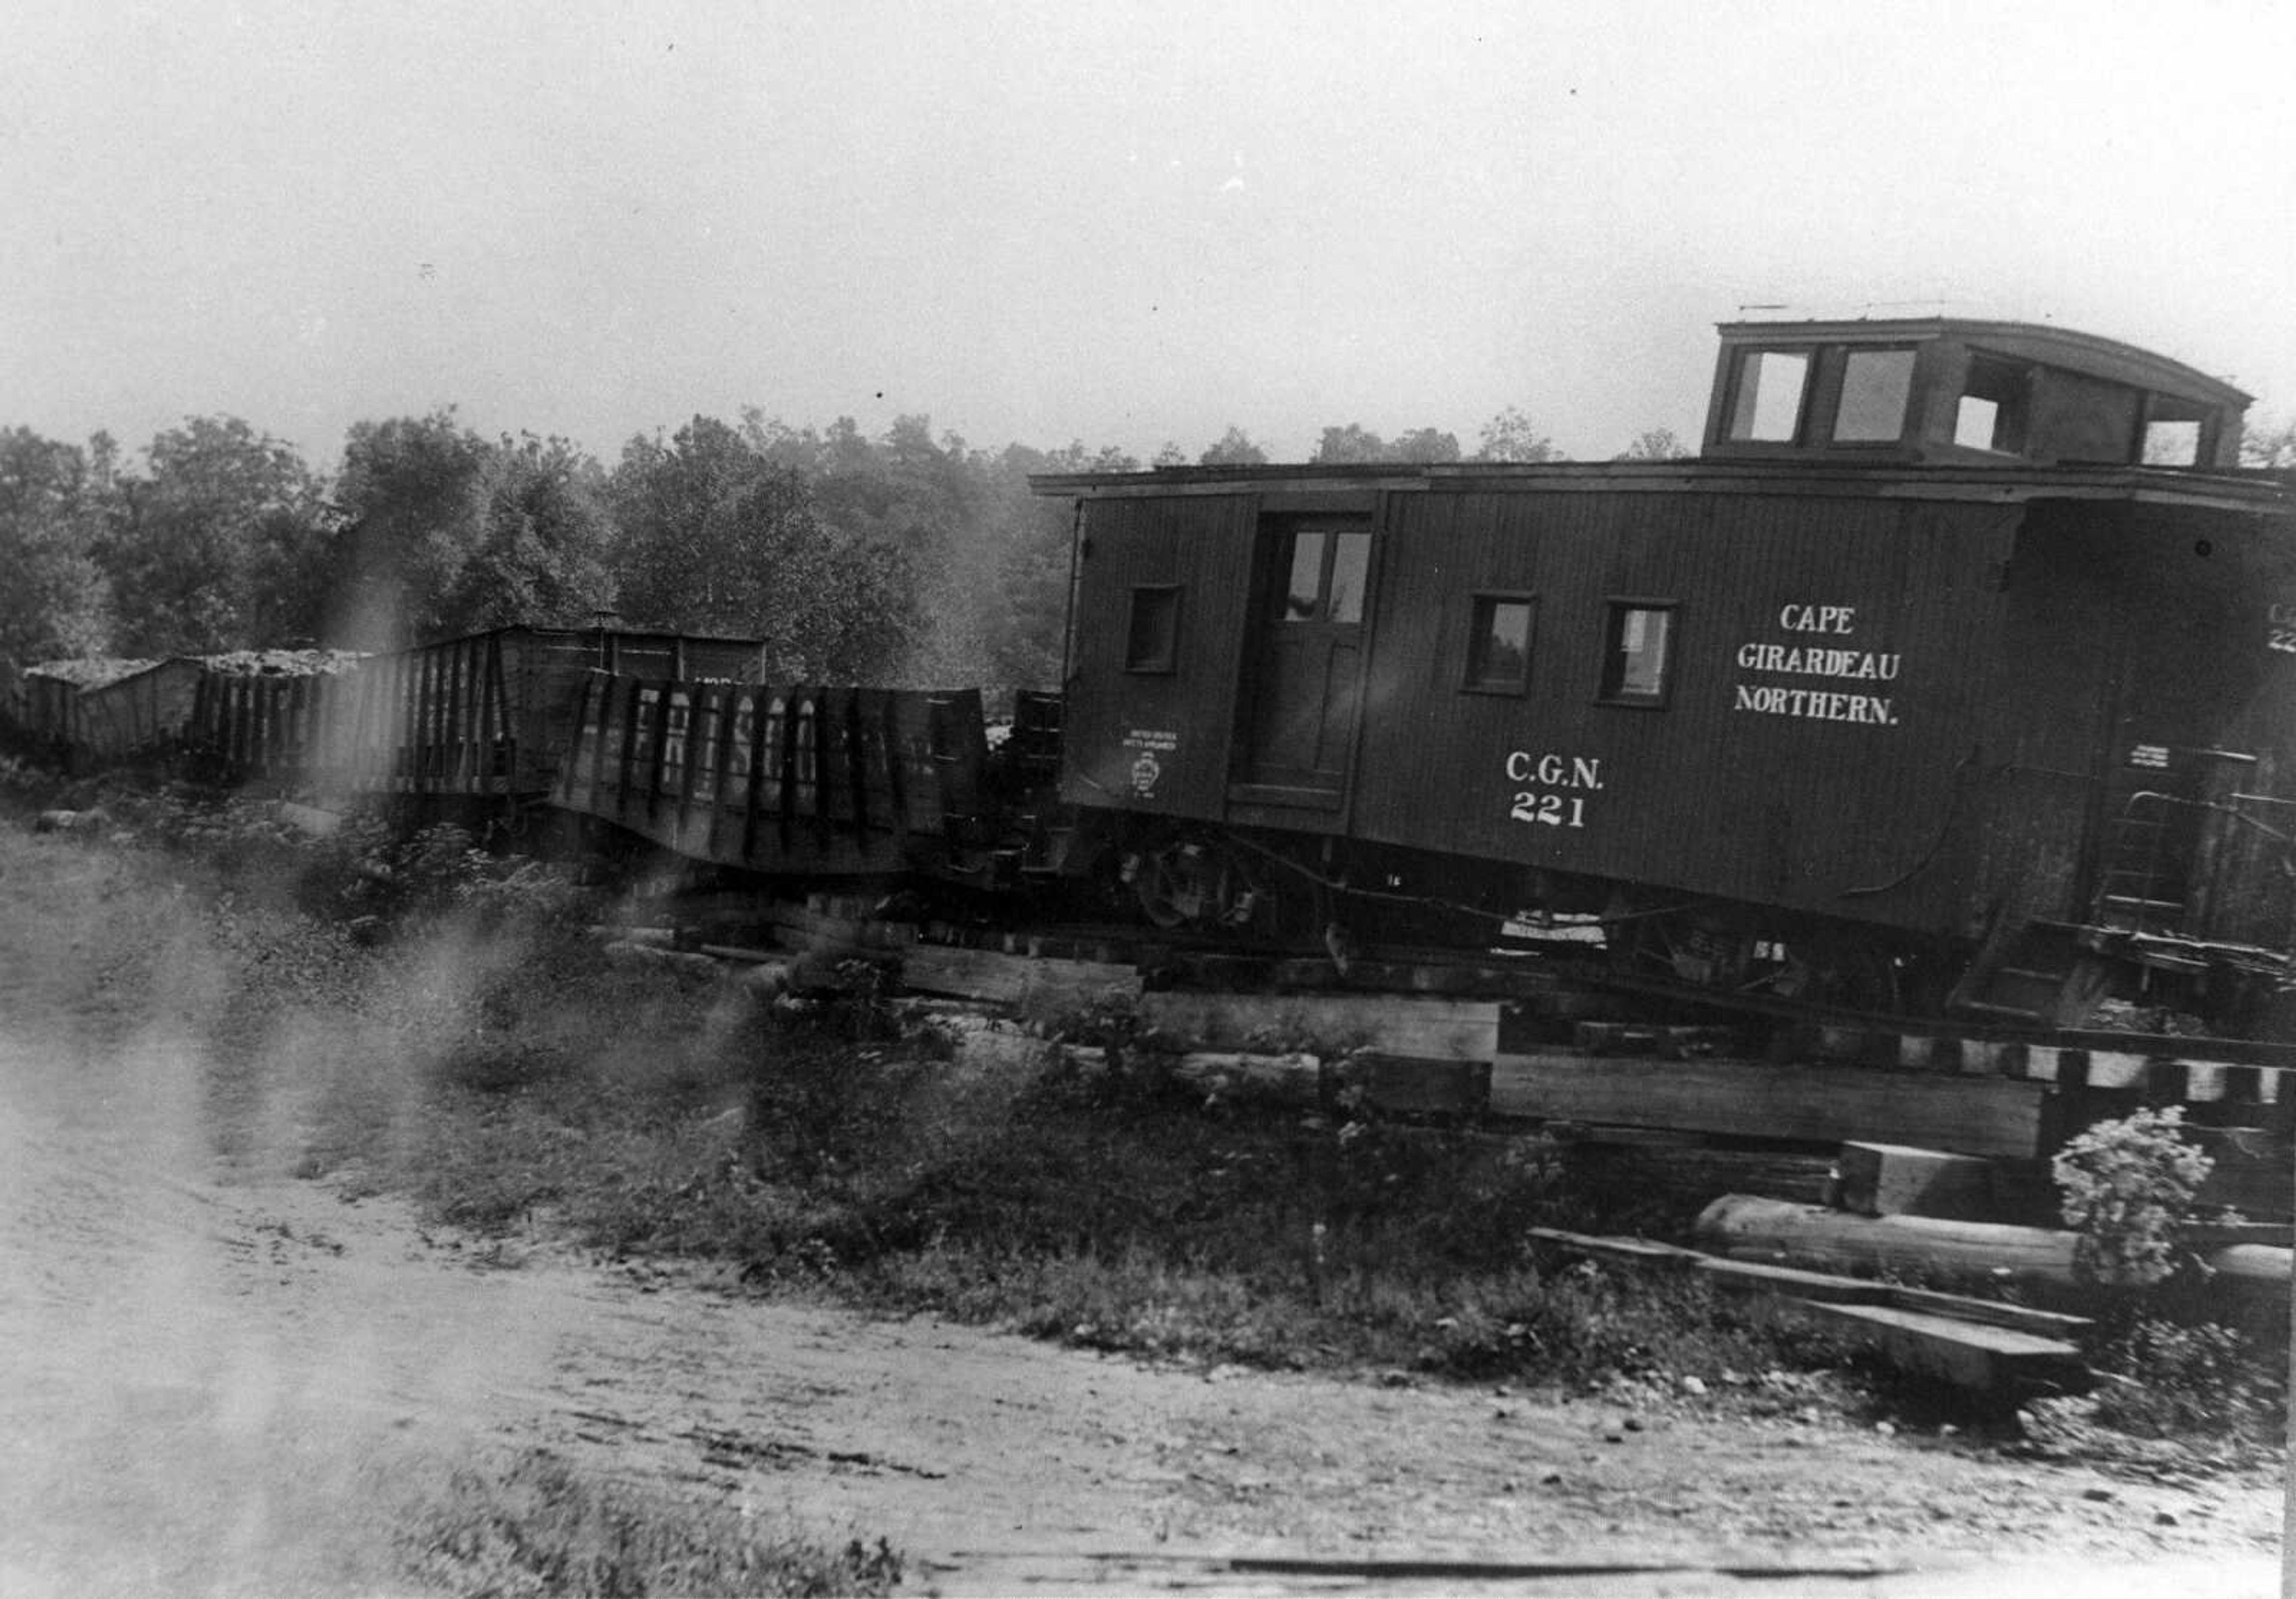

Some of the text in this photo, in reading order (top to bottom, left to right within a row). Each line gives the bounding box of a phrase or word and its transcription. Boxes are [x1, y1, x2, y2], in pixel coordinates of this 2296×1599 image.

[1779, 604, 1854, 634] CAPE
[1737, 643, 1901, 680] GIRARDEAU
[1734, 685, 1898, 725] NORTHERN.
[1506, 751, 1604, 789] C.G.N.
[1510, 792, 1584, 828] 221
